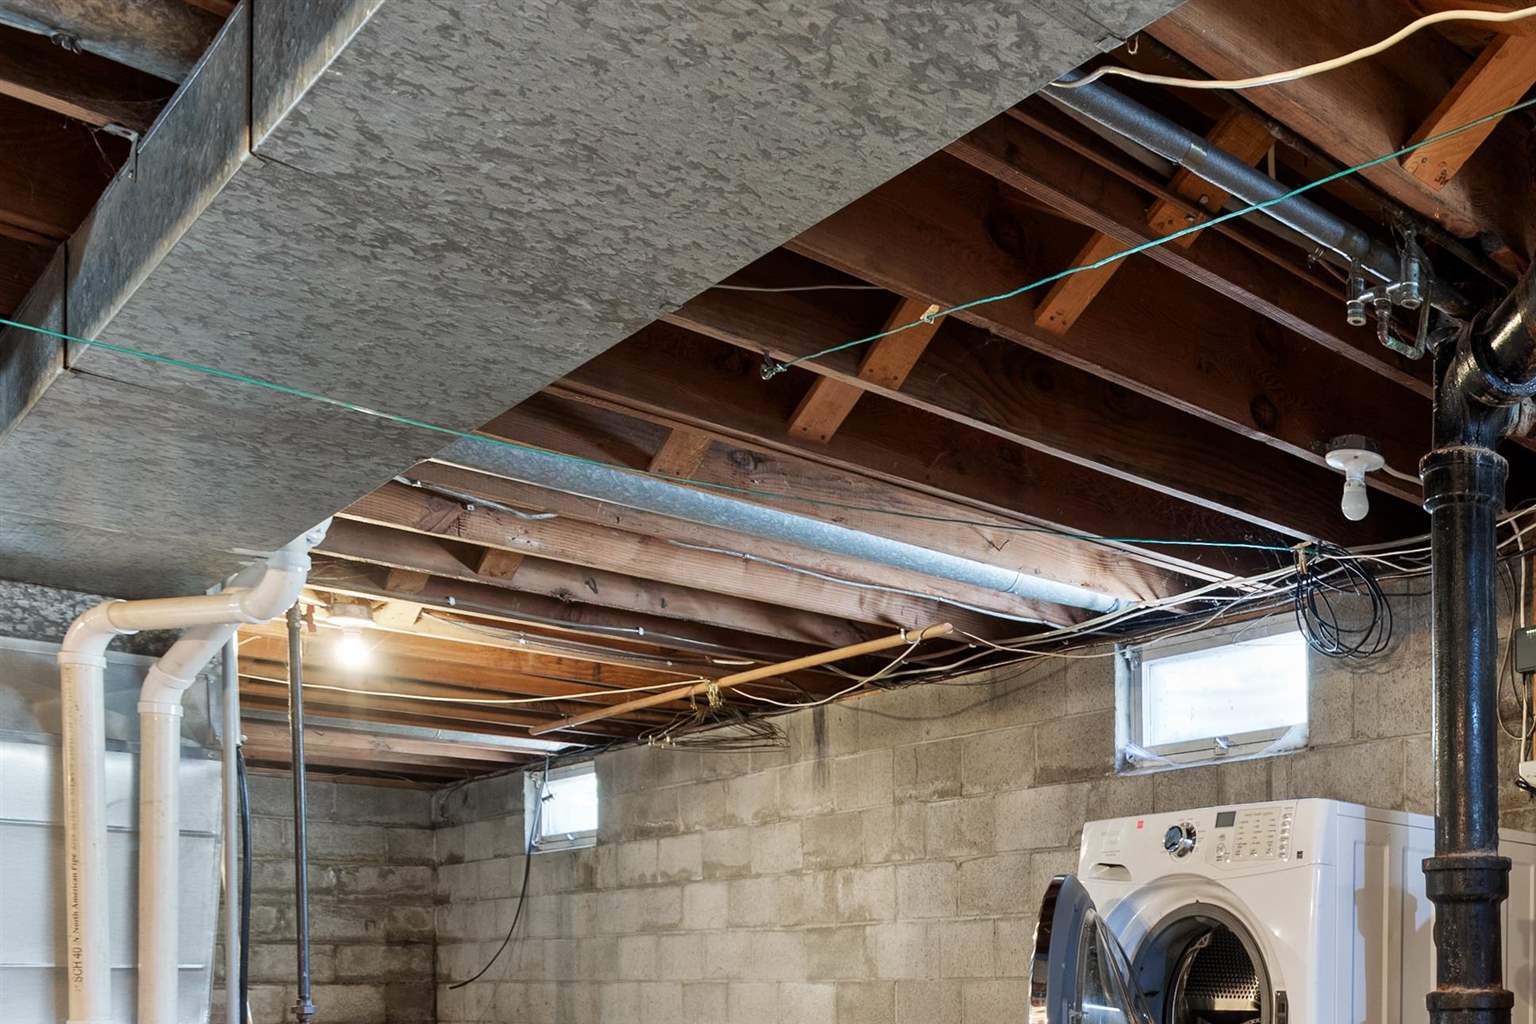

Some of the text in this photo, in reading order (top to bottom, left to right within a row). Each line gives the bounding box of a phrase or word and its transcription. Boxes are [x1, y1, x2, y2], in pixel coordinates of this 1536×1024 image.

[71, 873, 80, 909] American
[71, 910, 80, 935] North
[72, 947, 82, 960] 40
[72, 961, 83, 983] SCH
